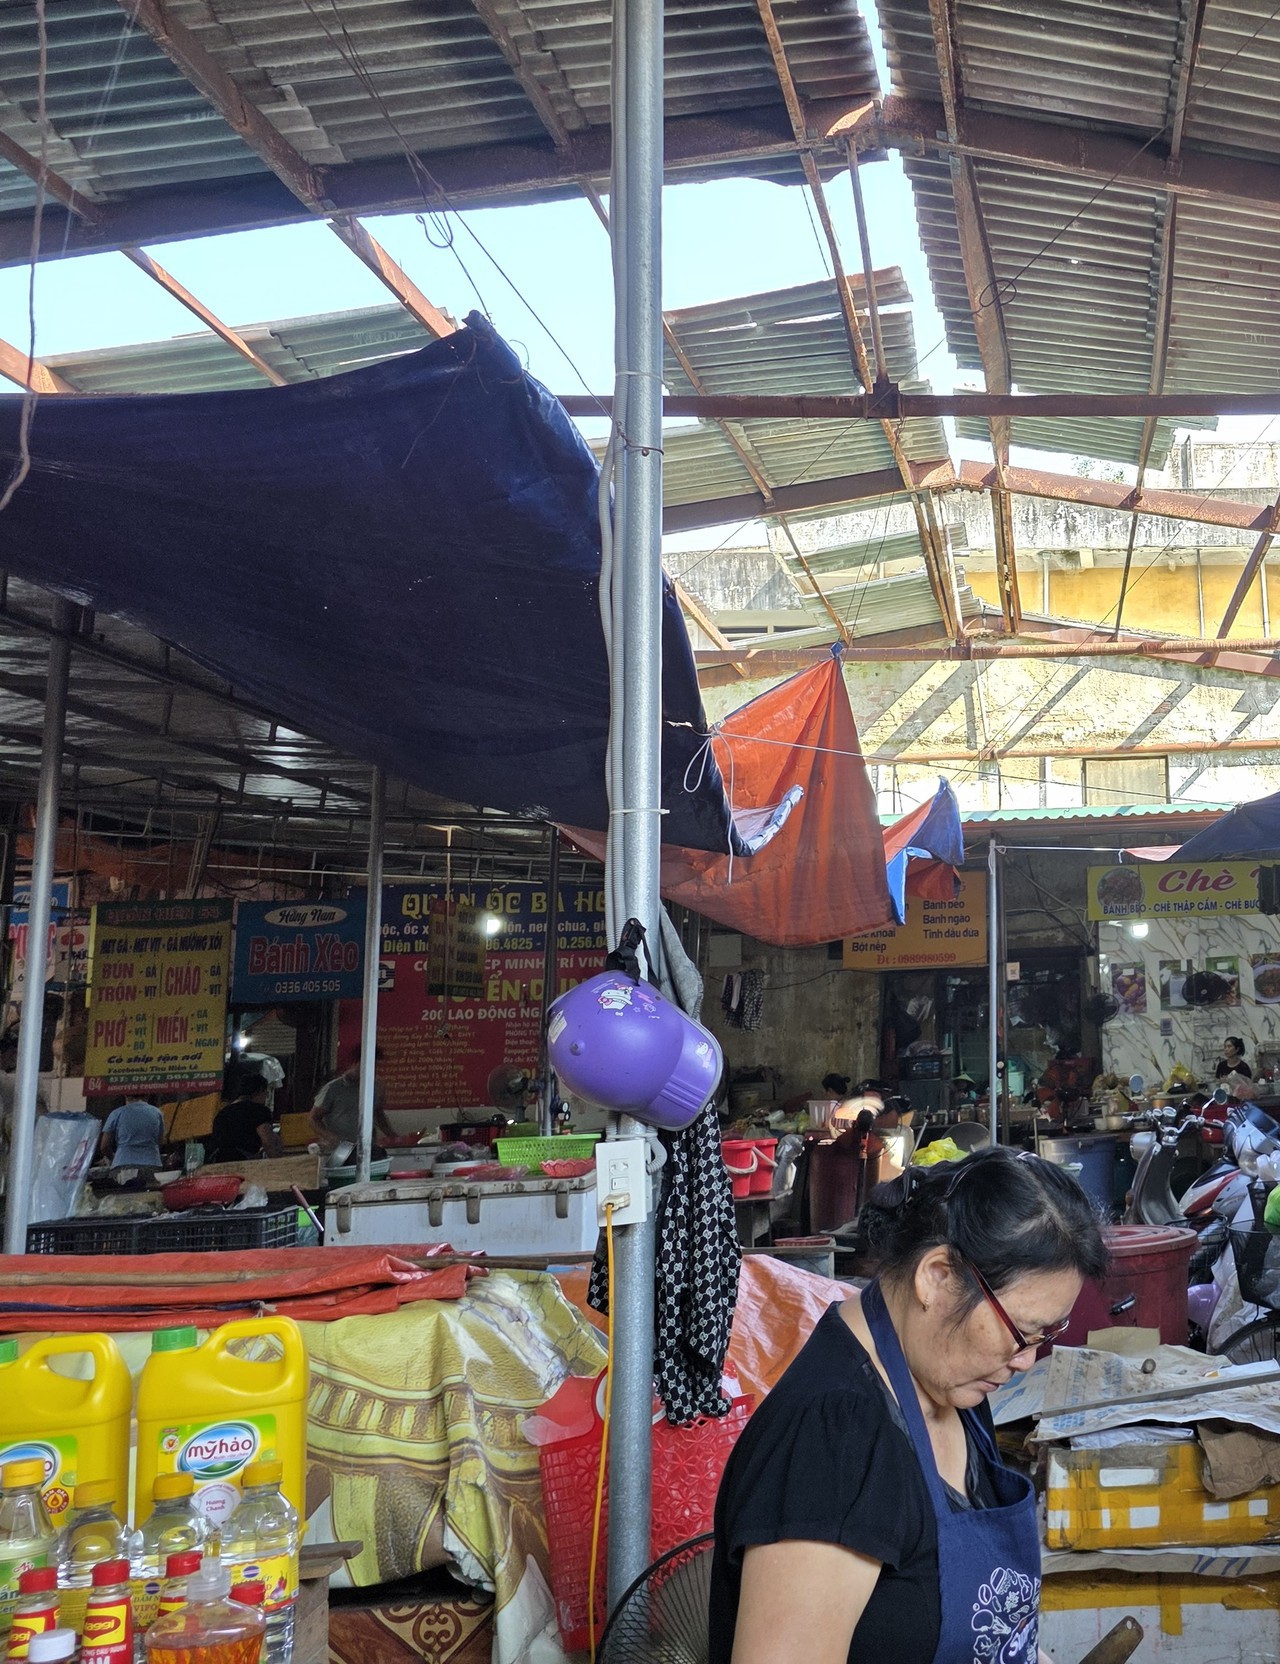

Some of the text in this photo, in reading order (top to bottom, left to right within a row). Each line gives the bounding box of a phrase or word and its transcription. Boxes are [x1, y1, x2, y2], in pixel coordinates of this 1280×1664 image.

[1157, 868, 1238, 894] Chè
[486, 882, 522, 914] ỐC
[1154, 899, 1171, 912] CHÈ
[1173, 900, 1196, 913] THẬP
[1197, 896, 1218, 910] CẨM
[923, 928, 943, 939] Tinh
[944, 926, 962, 938] dầu
[963, 926, 980, 938] dừa
[248, 932, 359, 976] Bánh Xèo
[383, 940, 411, 955] Điện
[851, 941, 887, 955] Bột nếp
[505, 957, 546, 970] MINH
[102, 959, 135, 980] BÚN
[164, 959, 202, 996] CHÁO
[275, 979, 341, 994] 0336 405 505
[448, 1008, 474, 1020] LAO
[478, 1004, 517, 1022] ĐỘNG
[93, 1009, 129, 1049] PHỞ
